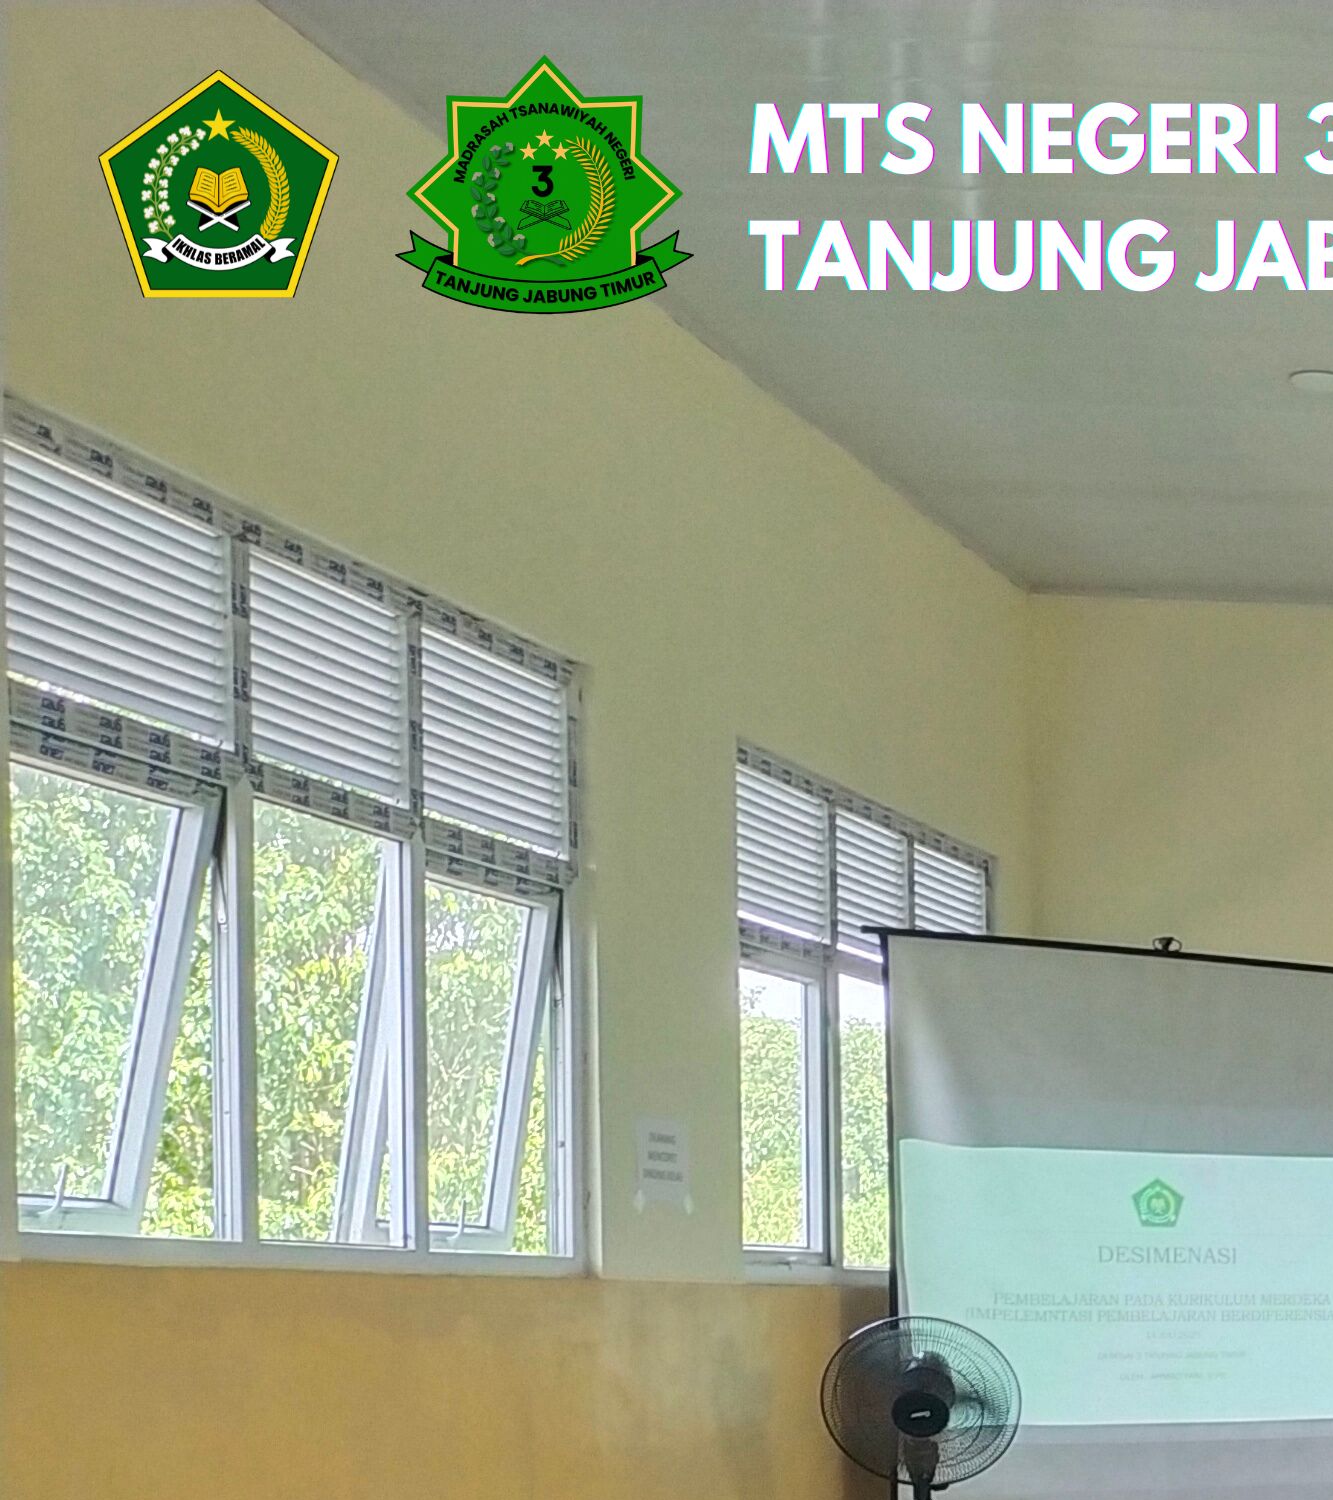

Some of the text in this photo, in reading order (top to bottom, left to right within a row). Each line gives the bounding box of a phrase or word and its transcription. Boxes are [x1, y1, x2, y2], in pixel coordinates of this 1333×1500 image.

[1097, 1245, 1237, 1264] DESIMENASI
[993, 1292, 1119, 1306] PEMBELAJARAN
[1124, 1293, 1164, 1306] PADA
